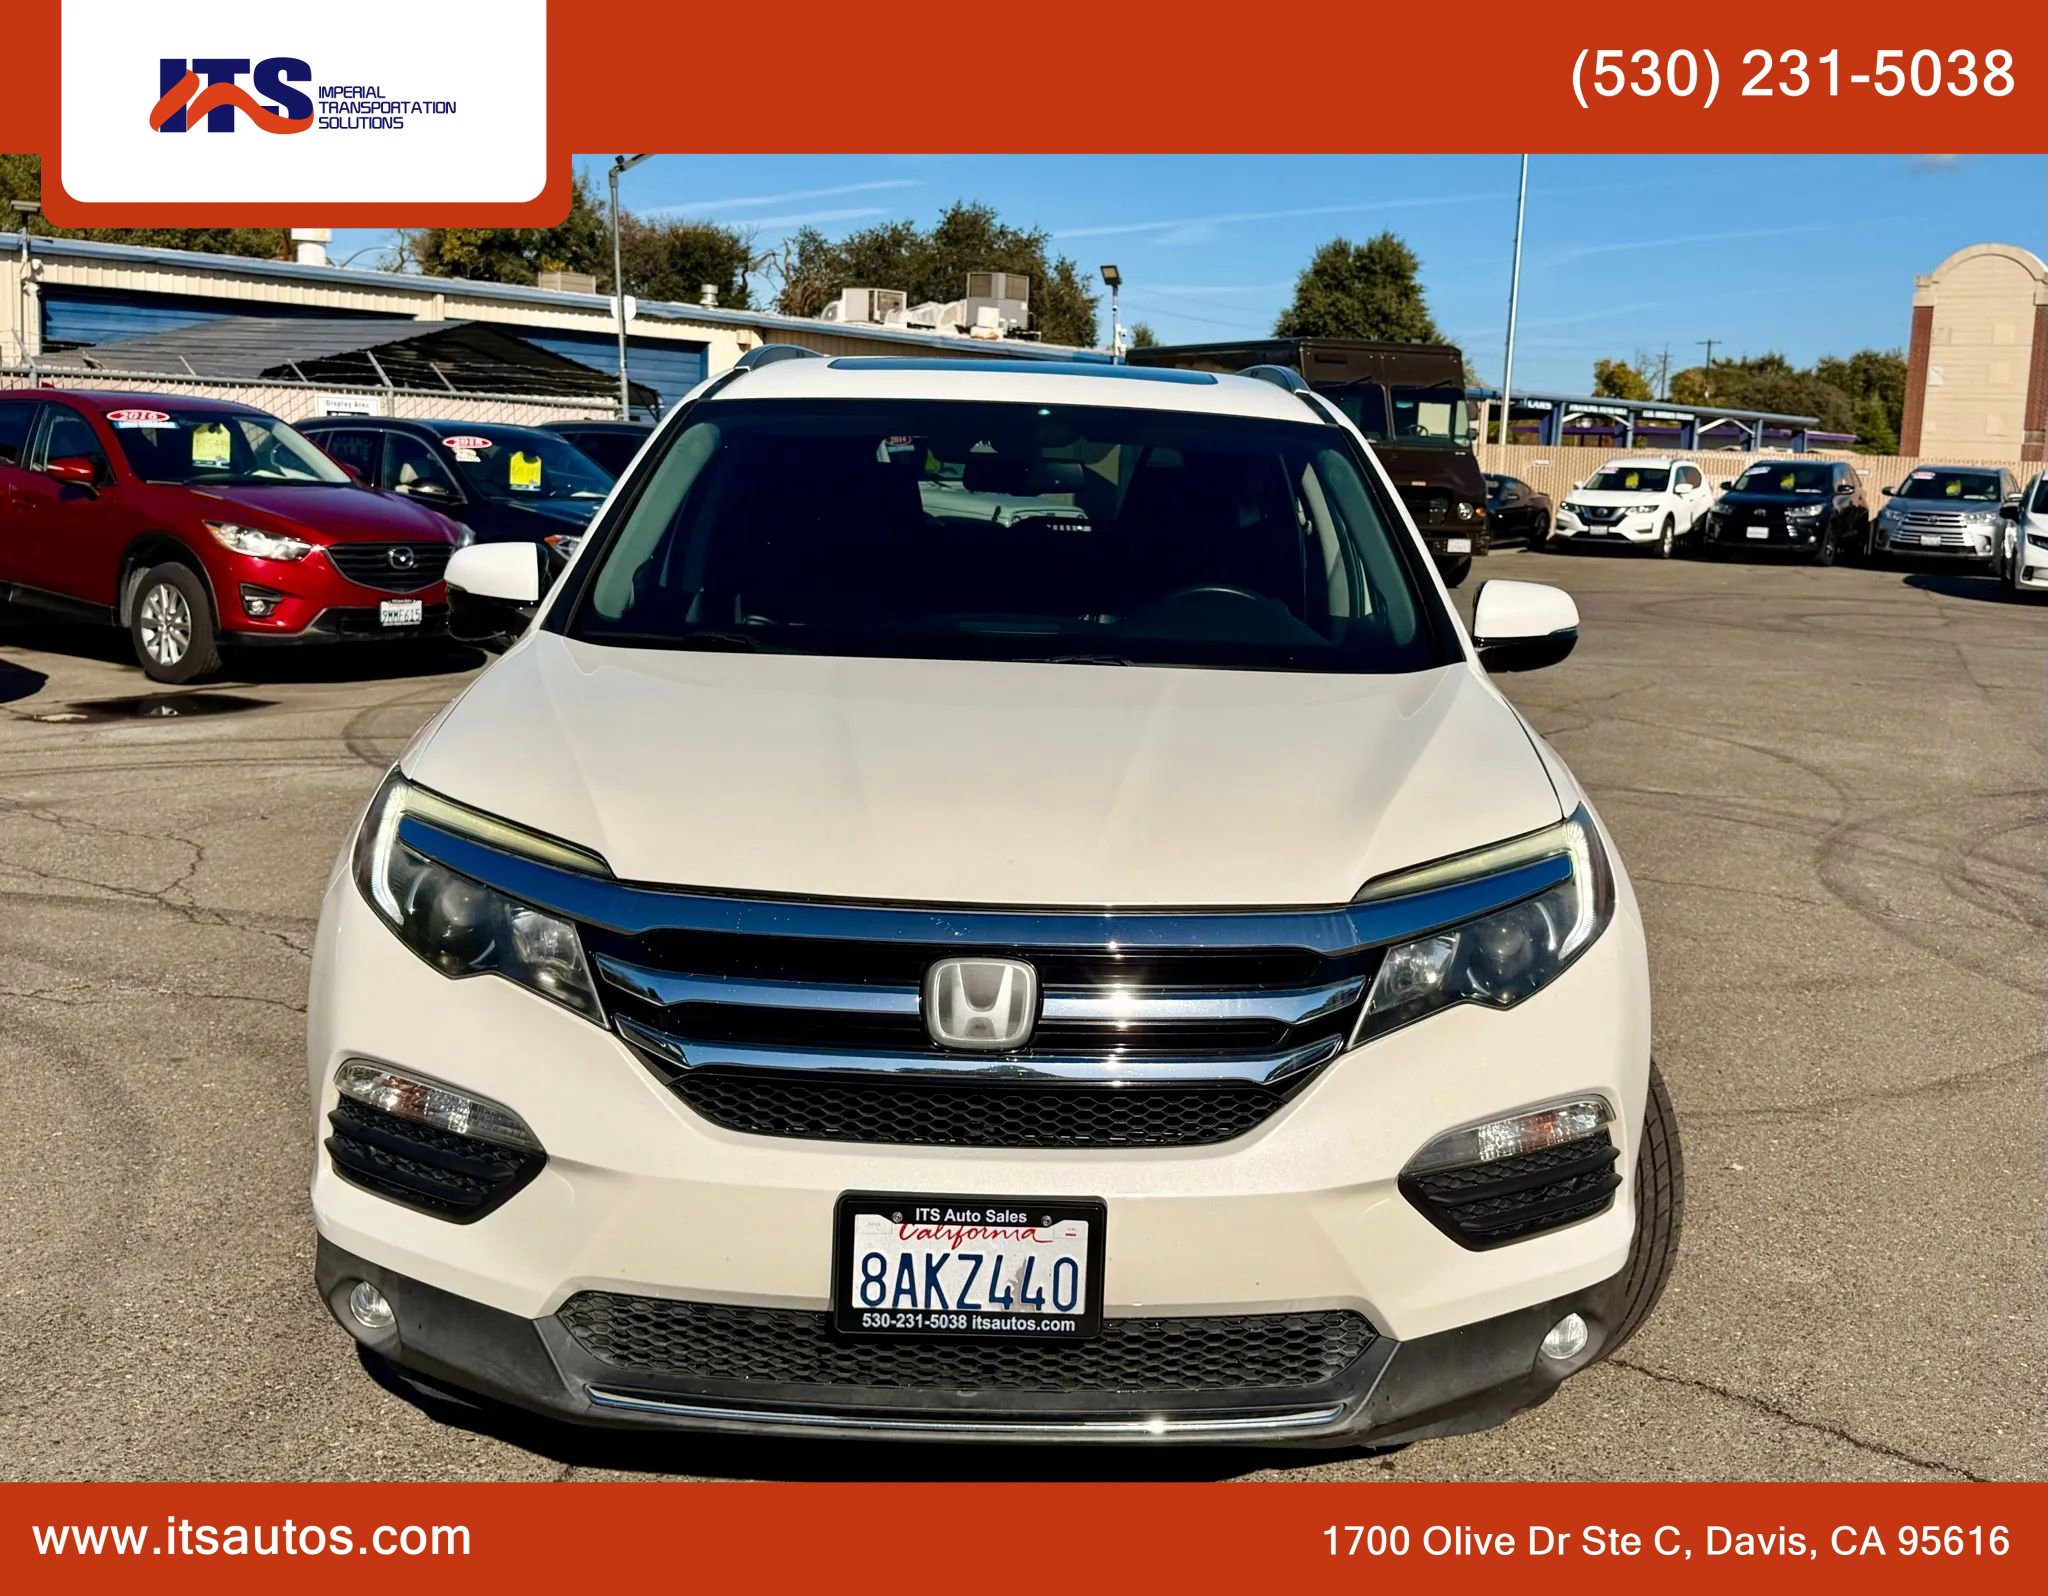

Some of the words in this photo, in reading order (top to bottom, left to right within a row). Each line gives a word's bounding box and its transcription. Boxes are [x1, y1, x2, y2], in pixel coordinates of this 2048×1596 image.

[326, 399, 352, 408] Display
[120, 411, 158, 420] 2016
[915, 1207, 941, 1222] ITS
[943, 1208, 980, 1223] Auto
[985, 1209, 1027, 1224] Sales
[898, 1222, 1054, 1250] California
[860, 1252, 1079, 1312] 8AKZ440
[862, 1313, 968, 1330] 530-231-5038
[972, 1315, 1076, 1331] itsautos.com
